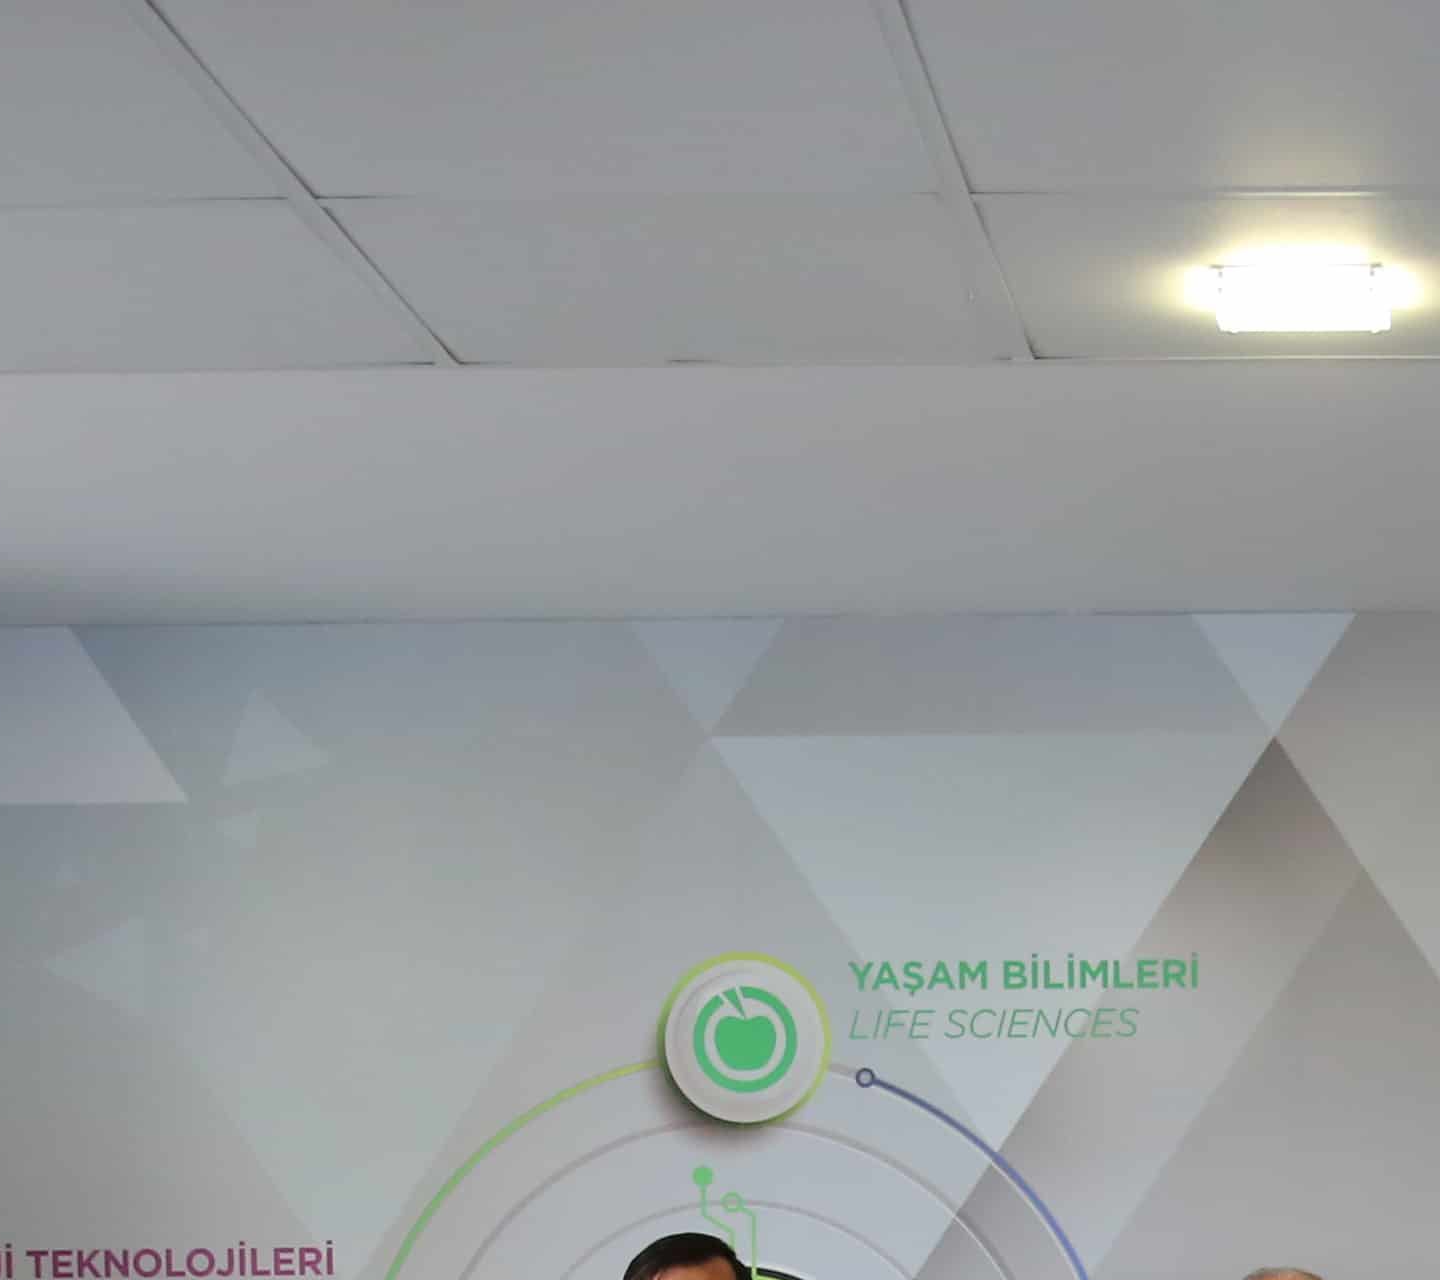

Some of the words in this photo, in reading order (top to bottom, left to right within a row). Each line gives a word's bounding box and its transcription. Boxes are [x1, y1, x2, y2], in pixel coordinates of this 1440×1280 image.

[847, 959, 989, 998] YAŞAM
[1002, 952, 1200, 990] BİLİMLERİ
[848, 1008, 937, 1040] LIFE
[944, 1007, 1140, 1040] SCIENCES
[26, 1240, 336, 1280] TEKNOLOJİLERİ
